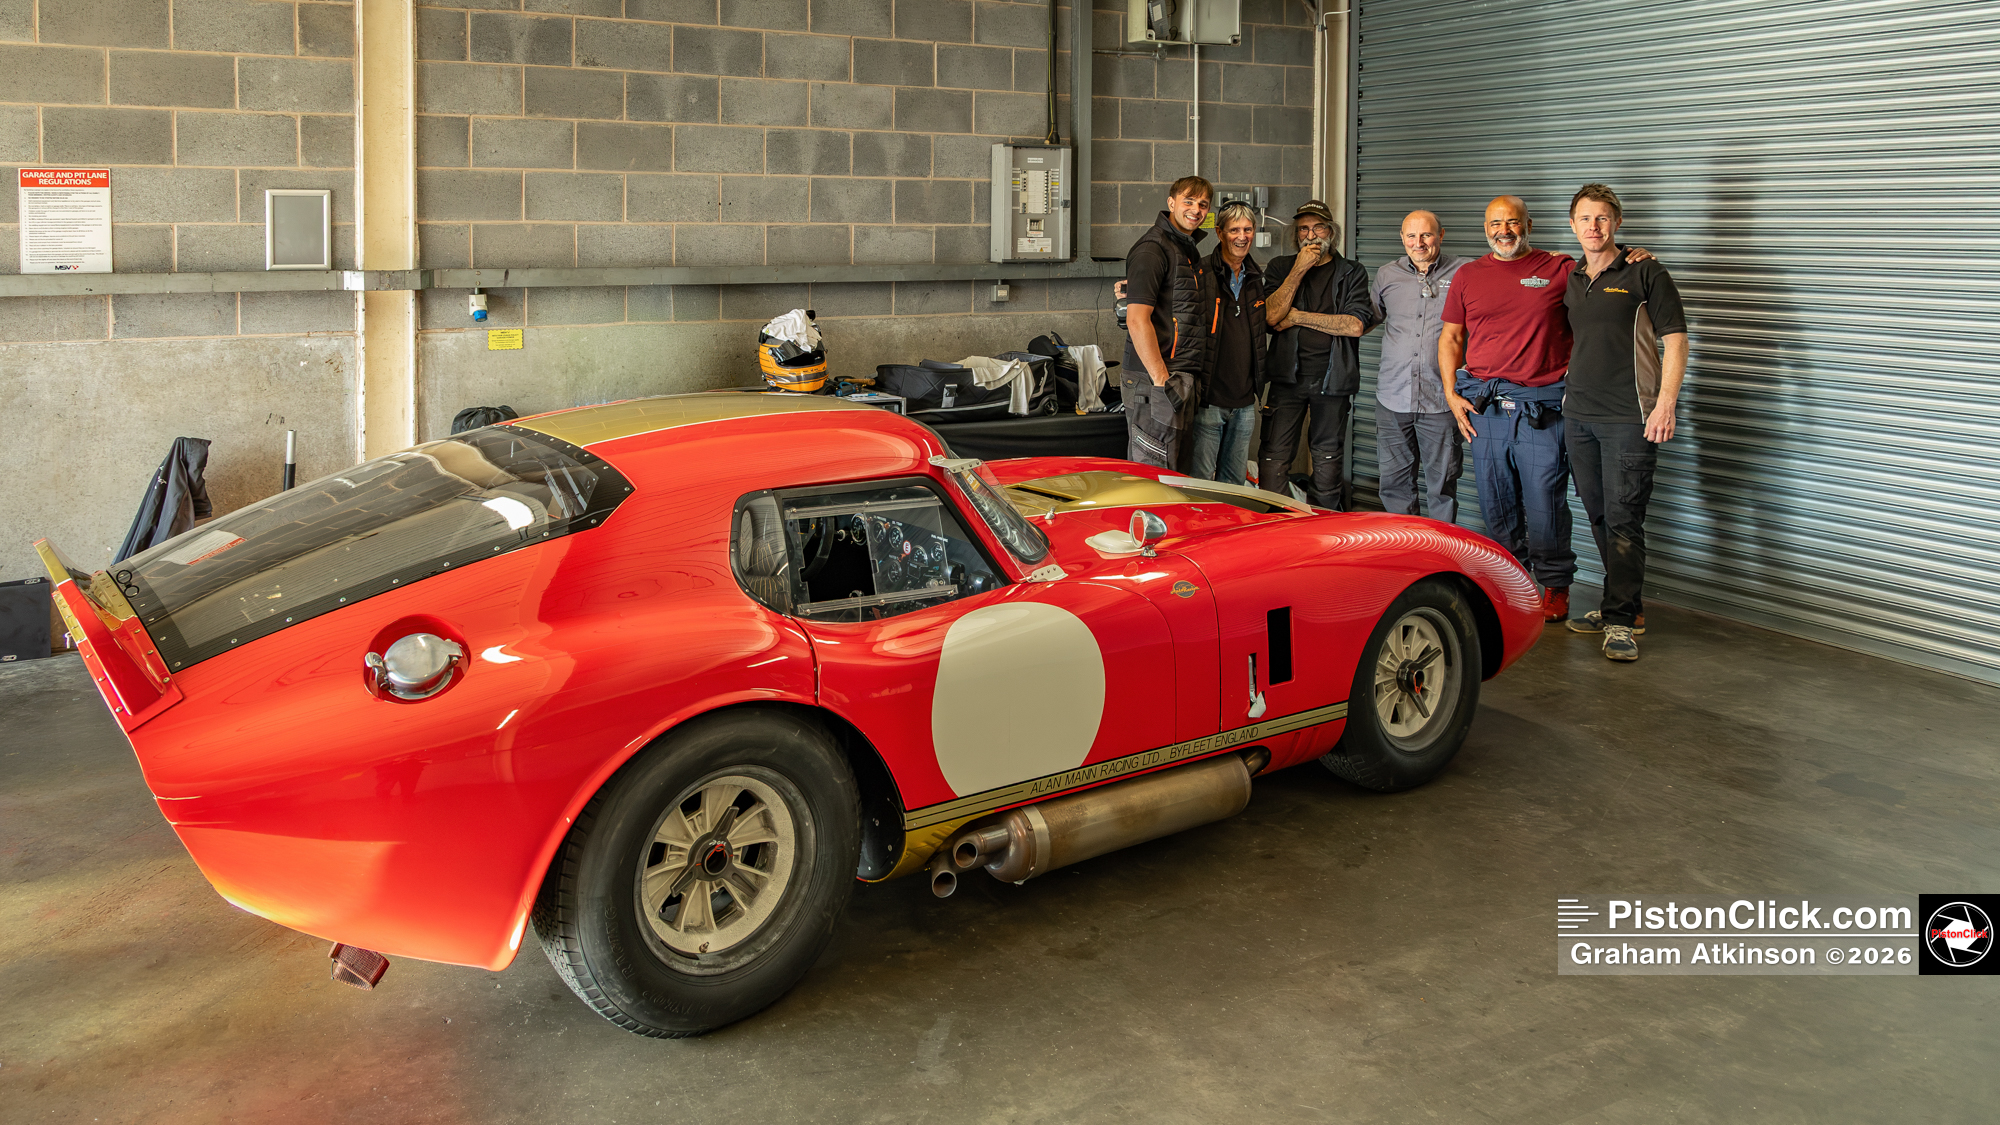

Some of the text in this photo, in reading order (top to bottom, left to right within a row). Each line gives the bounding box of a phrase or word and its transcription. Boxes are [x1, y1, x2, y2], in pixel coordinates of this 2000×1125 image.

[38, 178, 92, 186] REGULATIONS
[1030, 775, 1062, 795] ALAN
[1064, 767, 1098, 786] MANN
[1100, 756, 1139, 777] RACING
[1169, 737, 1213, 759] BYFLEET
[1215, 726, 1259, 748] ENGLAND
